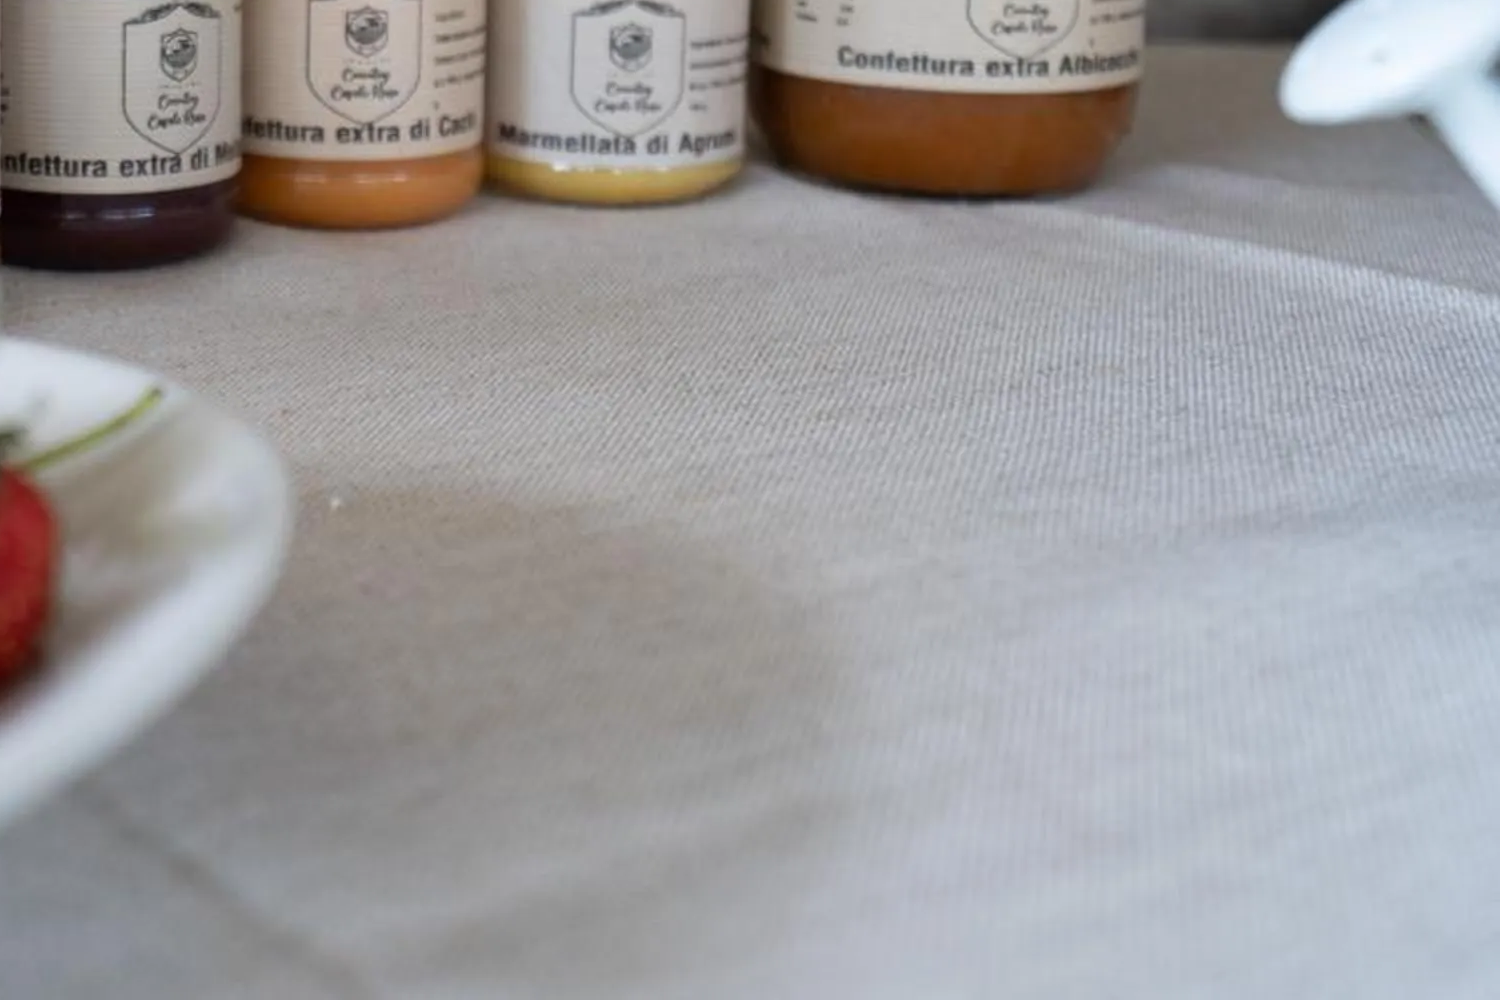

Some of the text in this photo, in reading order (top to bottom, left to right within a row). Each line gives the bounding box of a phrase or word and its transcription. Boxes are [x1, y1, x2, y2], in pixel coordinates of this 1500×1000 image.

[837, 45, 975, 77] Confettura
[985, 55, 1050, 77] extra
[335, 121, 400, 144] extra
[410, 118, 431, 141] di
[498, 121, 637, 155] Marmellata
[647, 133, 669, 155] di
[0, 152, 108, 178] nfettura
[119, 154, 183, 178] extra
[189, 148, 209, 171] di
